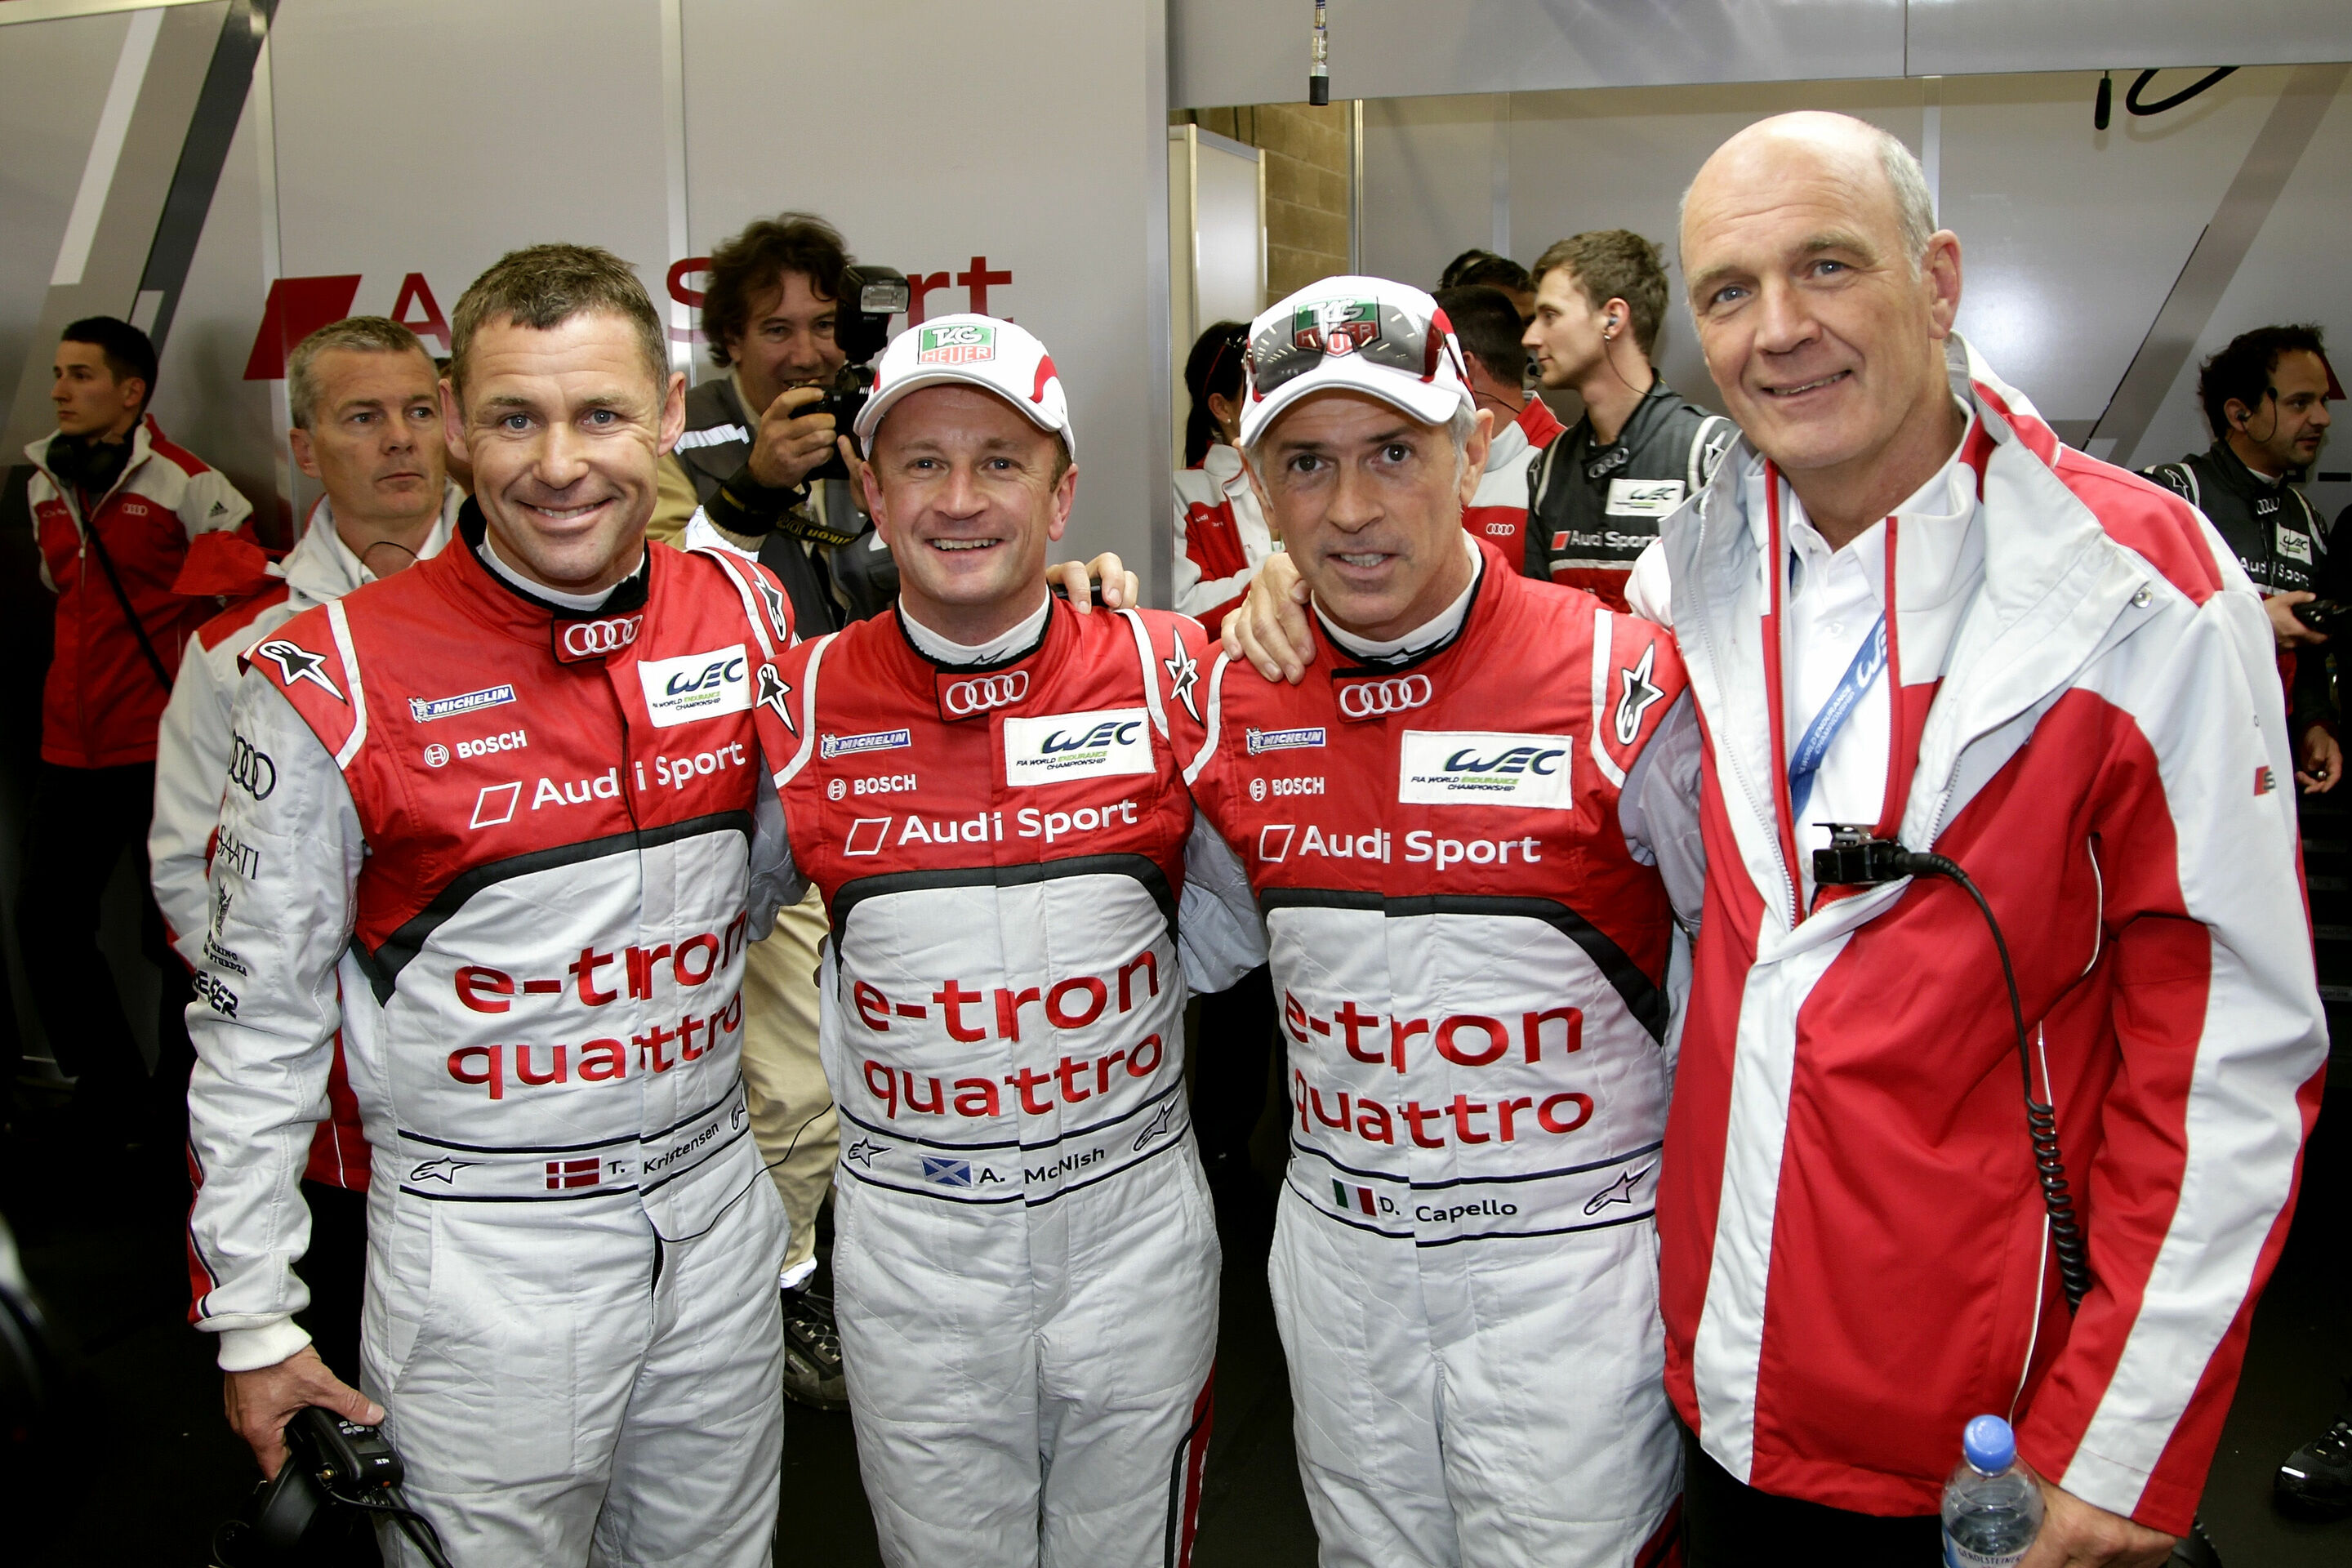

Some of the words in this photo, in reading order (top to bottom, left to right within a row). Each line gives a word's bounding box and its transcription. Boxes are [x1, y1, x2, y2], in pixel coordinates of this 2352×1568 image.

[931, 325, 984, 348] TAG
[924, 346, 989, 364] HEUER
[1569, 529, 1603, 547] Audi
[666, 657, 744, 697] WEC
[433, 688, 510, 715] MICHELIN
[675, 698, 721, 711] CHAMPIONSHIP
[684, 691, 721, 703] ENDURANCE
[1815, 684, 1852, 739] ENDURANCE
[456, 730, 528, 760] BOSCH
[839, 733, 906, 750] MICHELIN
[1041, 721, 1143, 755] WEC
[1263, 731, 1322, 746] MICHELIN
[1029, 757, 1057, 766] WORLD
[1057, 751, 1108, 763] ENDURANCE
[1046, 758, 1107, 771] CHAMPIONSHIP
[1443, 746, 1566, 776] WEC
[531, 760, 646, 811] Audi
[655, 740, 746, 791] Sport
[853, 773, 918, 795] BOSCH
[1272, 777, 1325, 796] BOSCH
[1428, 776, 1459, 784] WORLD
[1460, 777, 1520, 786] ENDURANCE
[1447, 784, 1516, 792] CHAMPIONSHIP
[898, 811, 1004, 846] Audi
[1018, 799, 1138, 843] Sport
[216, 824, 260, 880] SAATI
[1298, 824, 1392, 864] Audi
[1404, 830, 1542, 871] Sport
[454, 910, 748, 1013] e-tron
[853, 950, 1160, 1043] e-tron
[447, 990, 742, 1100] quattro
[1285, 987, 1584, 1074] e-tron
[863, 1032, 1163, 1120] quattro
[1294, 1067, 1595, 1150] quattro
[607, 1160, 626, 1175] T.
[643, 1121, 720, 1175] Kristensen
[978, 1167, 1005, 1184] A.
[1024, 1147, 1106, 1185] McNish
[1379, 1196, 1401, 1216] D.
[1414, 1199, 1518, 1223] Capello
